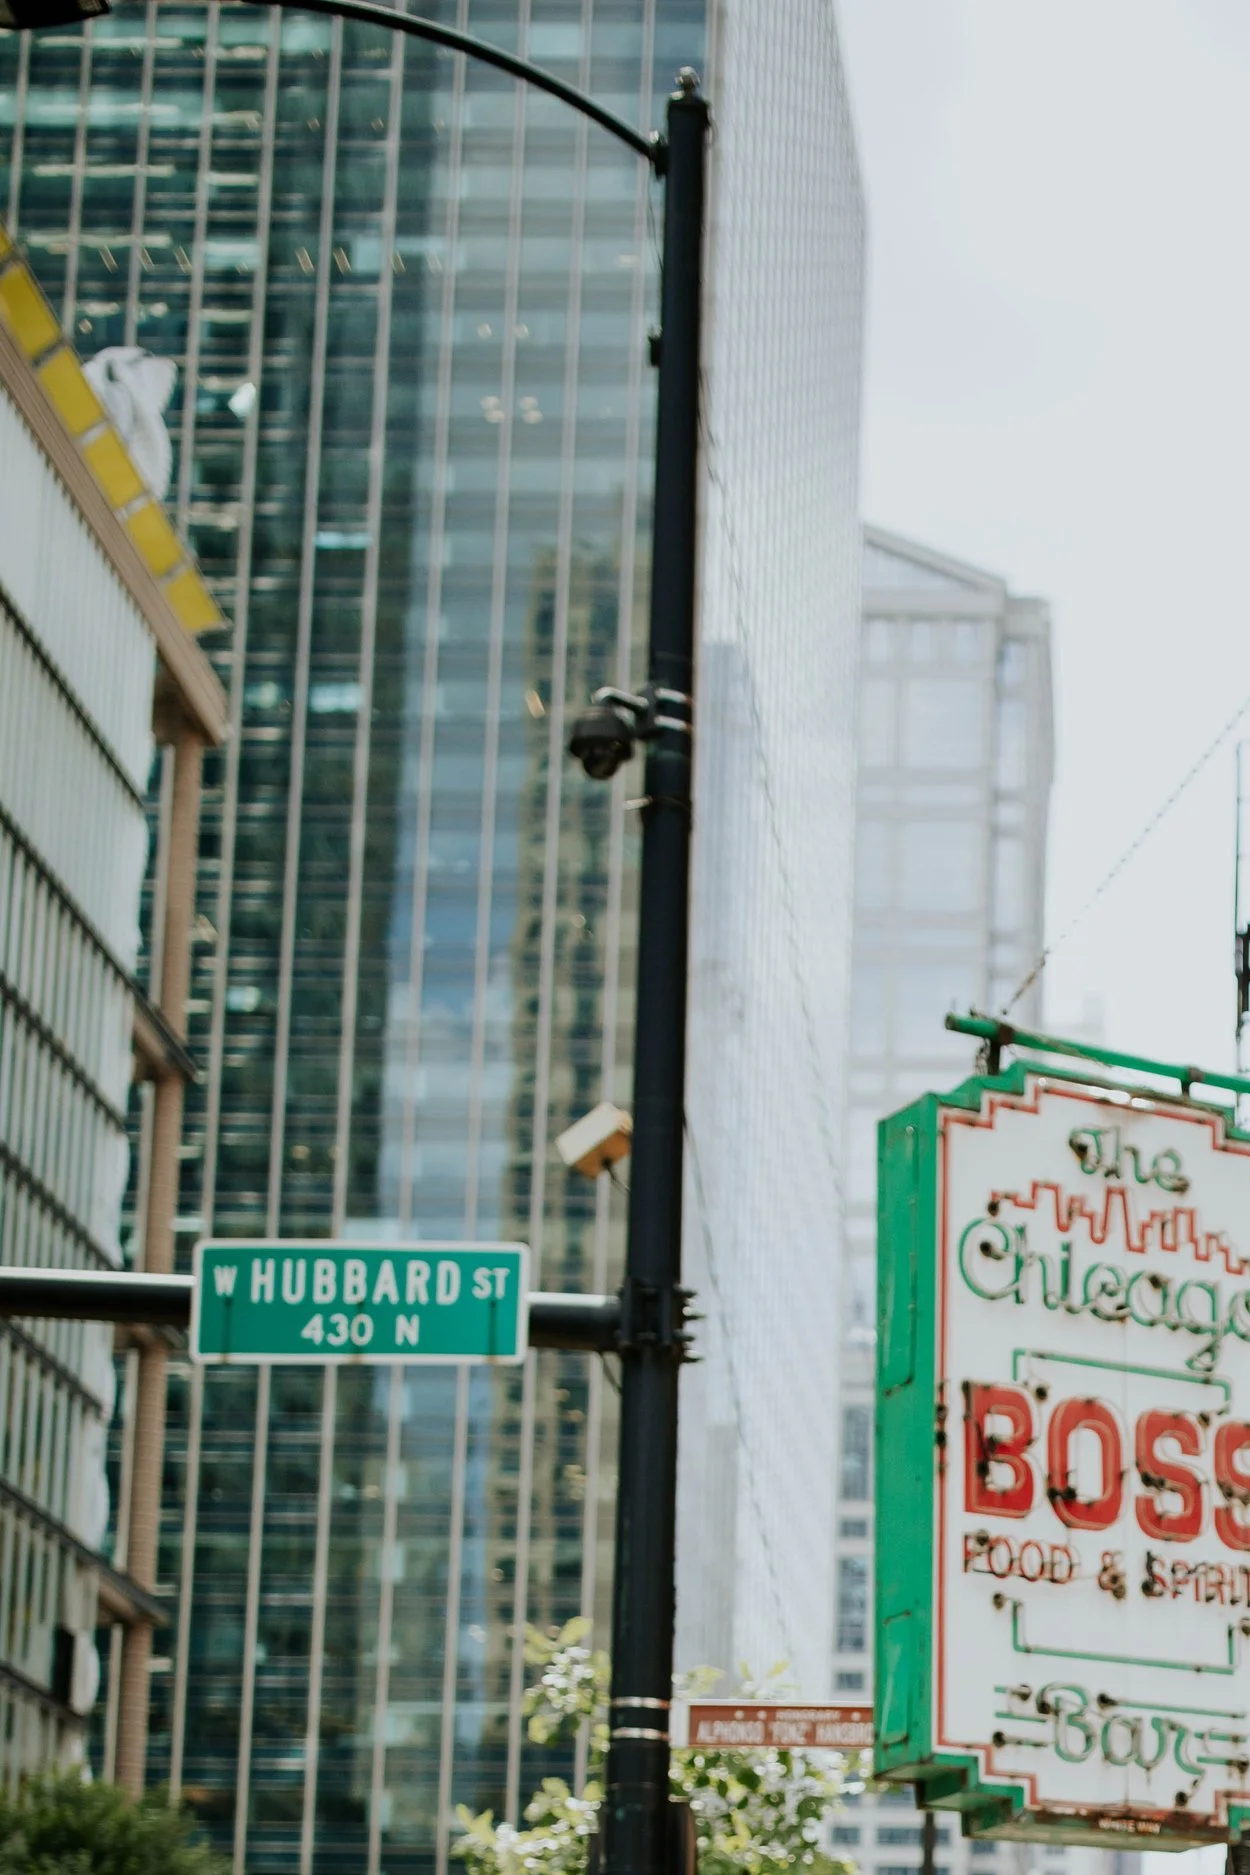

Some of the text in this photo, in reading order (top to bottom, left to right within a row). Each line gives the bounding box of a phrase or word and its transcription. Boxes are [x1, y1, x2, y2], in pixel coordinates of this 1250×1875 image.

[1067, 1125, 1191, 1194] The
[213, 1257, 511, 1306] W HUBBARD ST
[300, 1313, 420, 1347] 430 N
[963, 1532, 1076, 1585] FOOD
[1098, 1551, 1126, 1600] &
[1035, 1682, 1206, 1776] Bar
